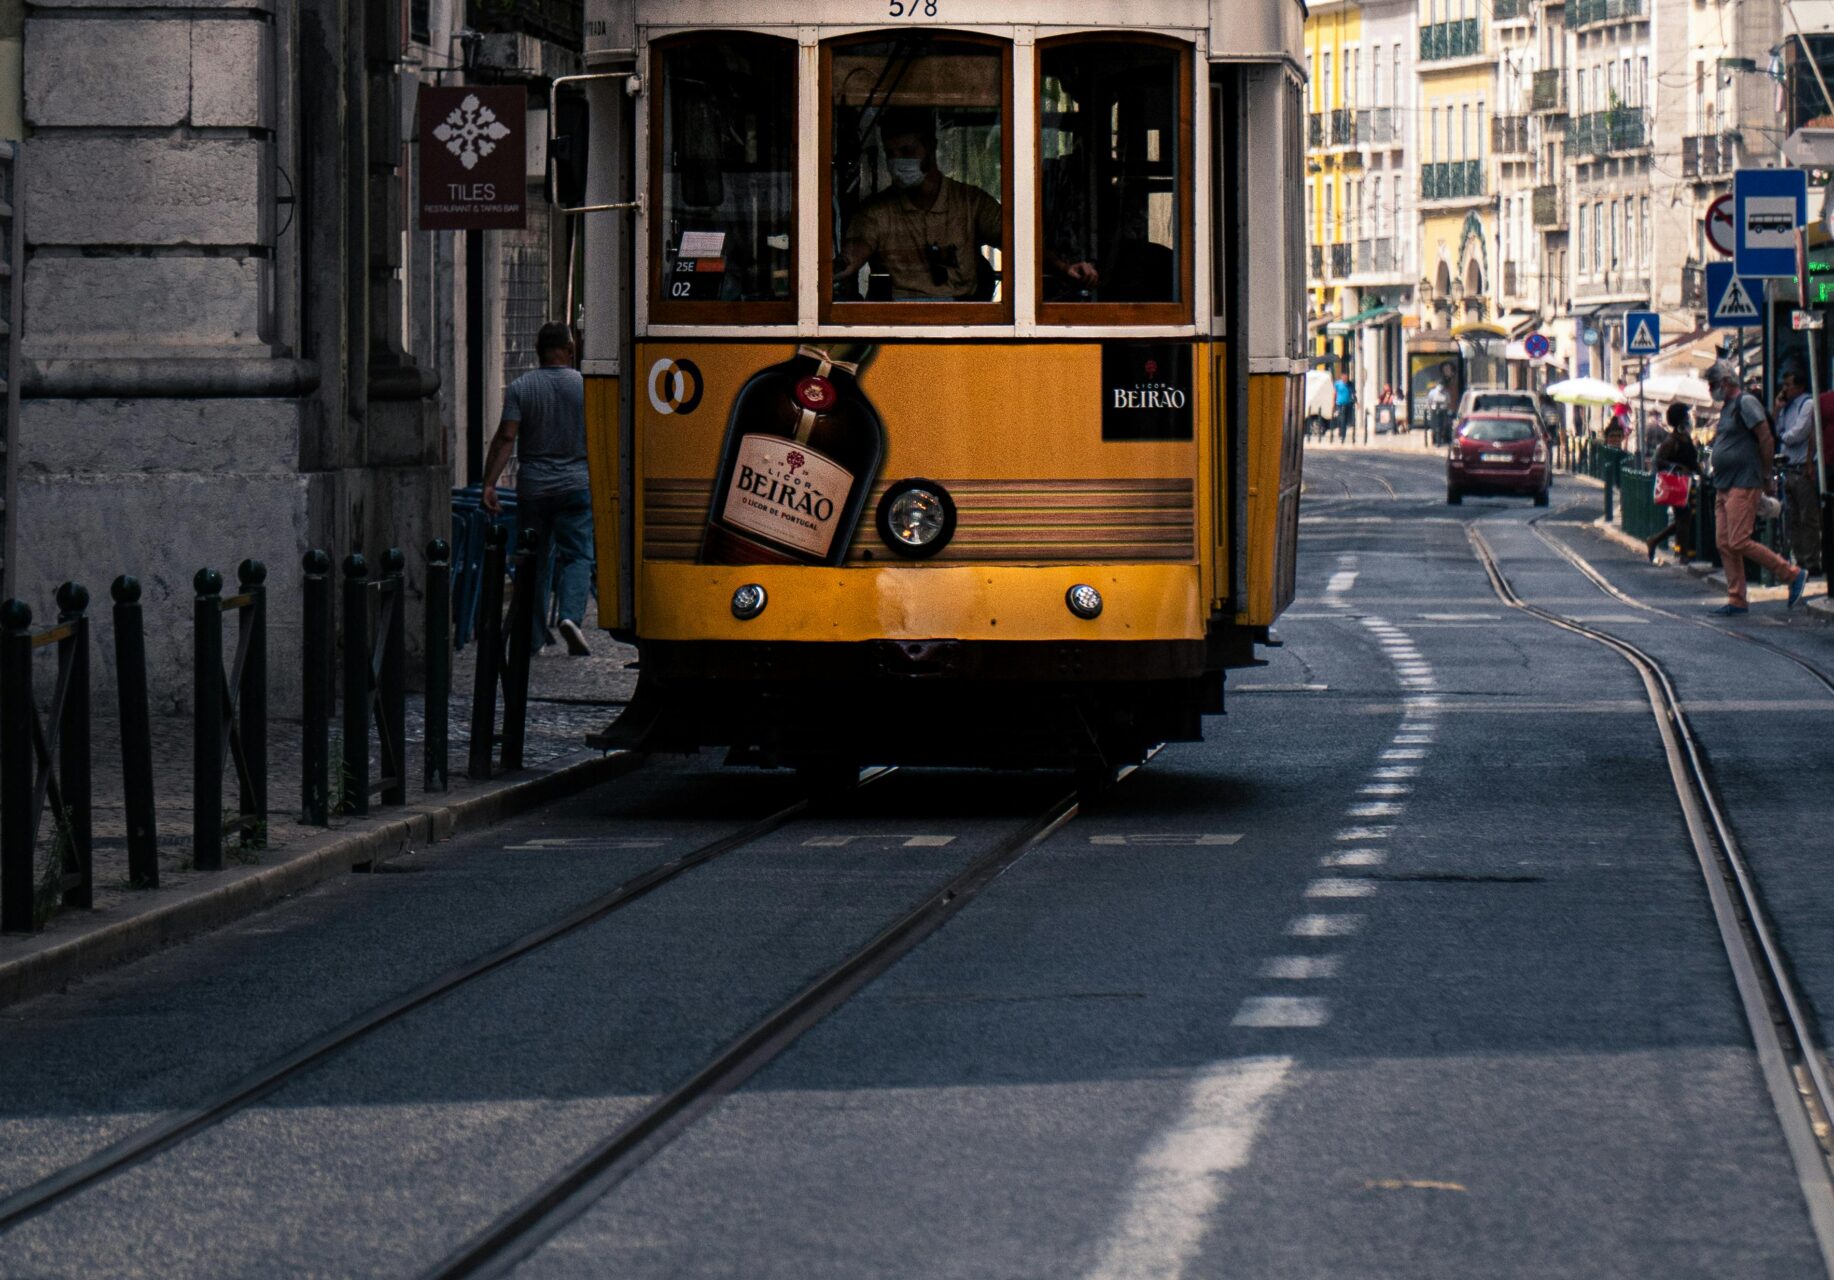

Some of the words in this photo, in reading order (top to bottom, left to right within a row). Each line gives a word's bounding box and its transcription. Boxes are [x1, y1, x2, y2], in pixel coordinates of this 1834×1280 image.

[447, 183, 496, 201] TILES
[424, 203, 471, 213] RESTAURANT
[503, 203, 519, 213] BAR
[676, 261, 695, 272] 25E
[672, 282, 691, 297] 02
[1113, 387, 1185, 408] BEIRÃO
[768, 467, 812, 489] LICOR
[737, 464, 834, 521] BEIRÃO
[742, 496, 747, 504] O
[748, 498, 768, 512] LICOR
[769, 507, 779, 517] DE
[781, 511, 818, 531] PORTUGAL
